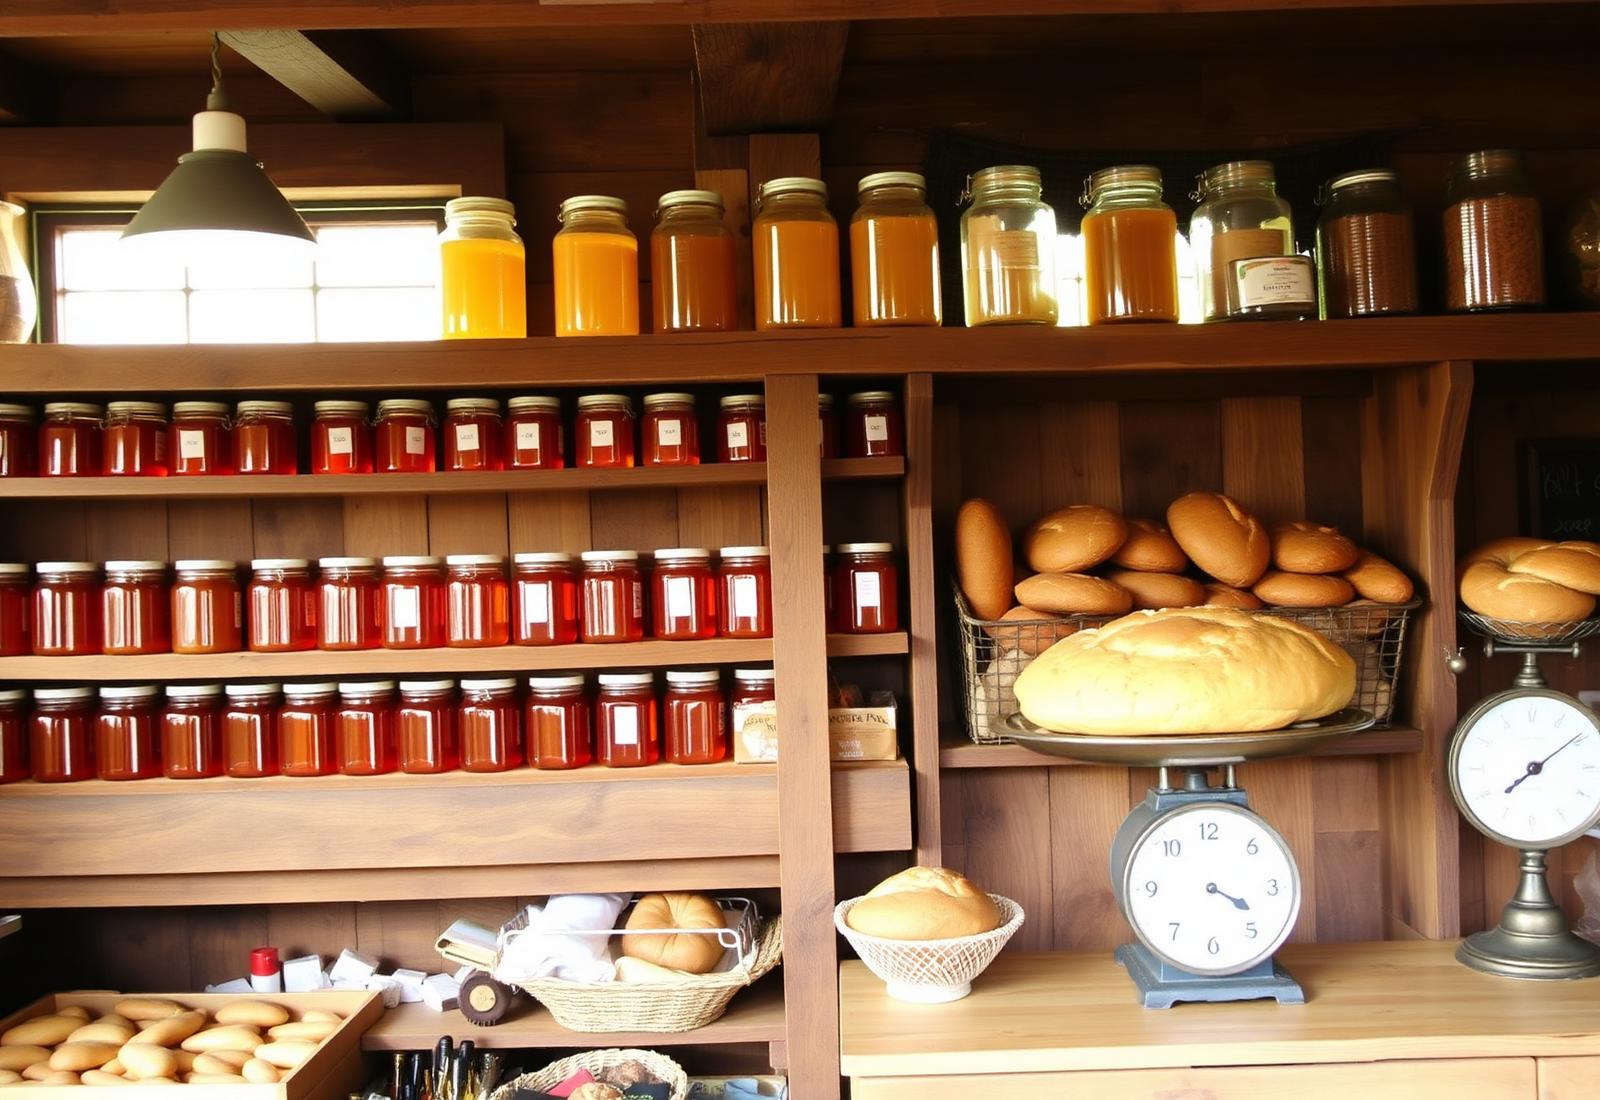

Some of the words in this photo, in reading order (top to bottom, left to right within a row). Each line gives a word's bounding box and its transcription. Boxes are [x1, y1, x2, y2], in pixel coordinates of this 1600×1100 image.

[1199, 823, 1219, 840] 12
[1163, 839, 1181, 857] 10
[1246, 838, 1259, 855] 6
[1145, 881, 1158, 898] 9
[1267, 879, 1279, 896] 3
[1168, 922, 1181, 941] 7
[1245, 922, 1258, 939] 5
[1207, 936, 1220, 955] 6
